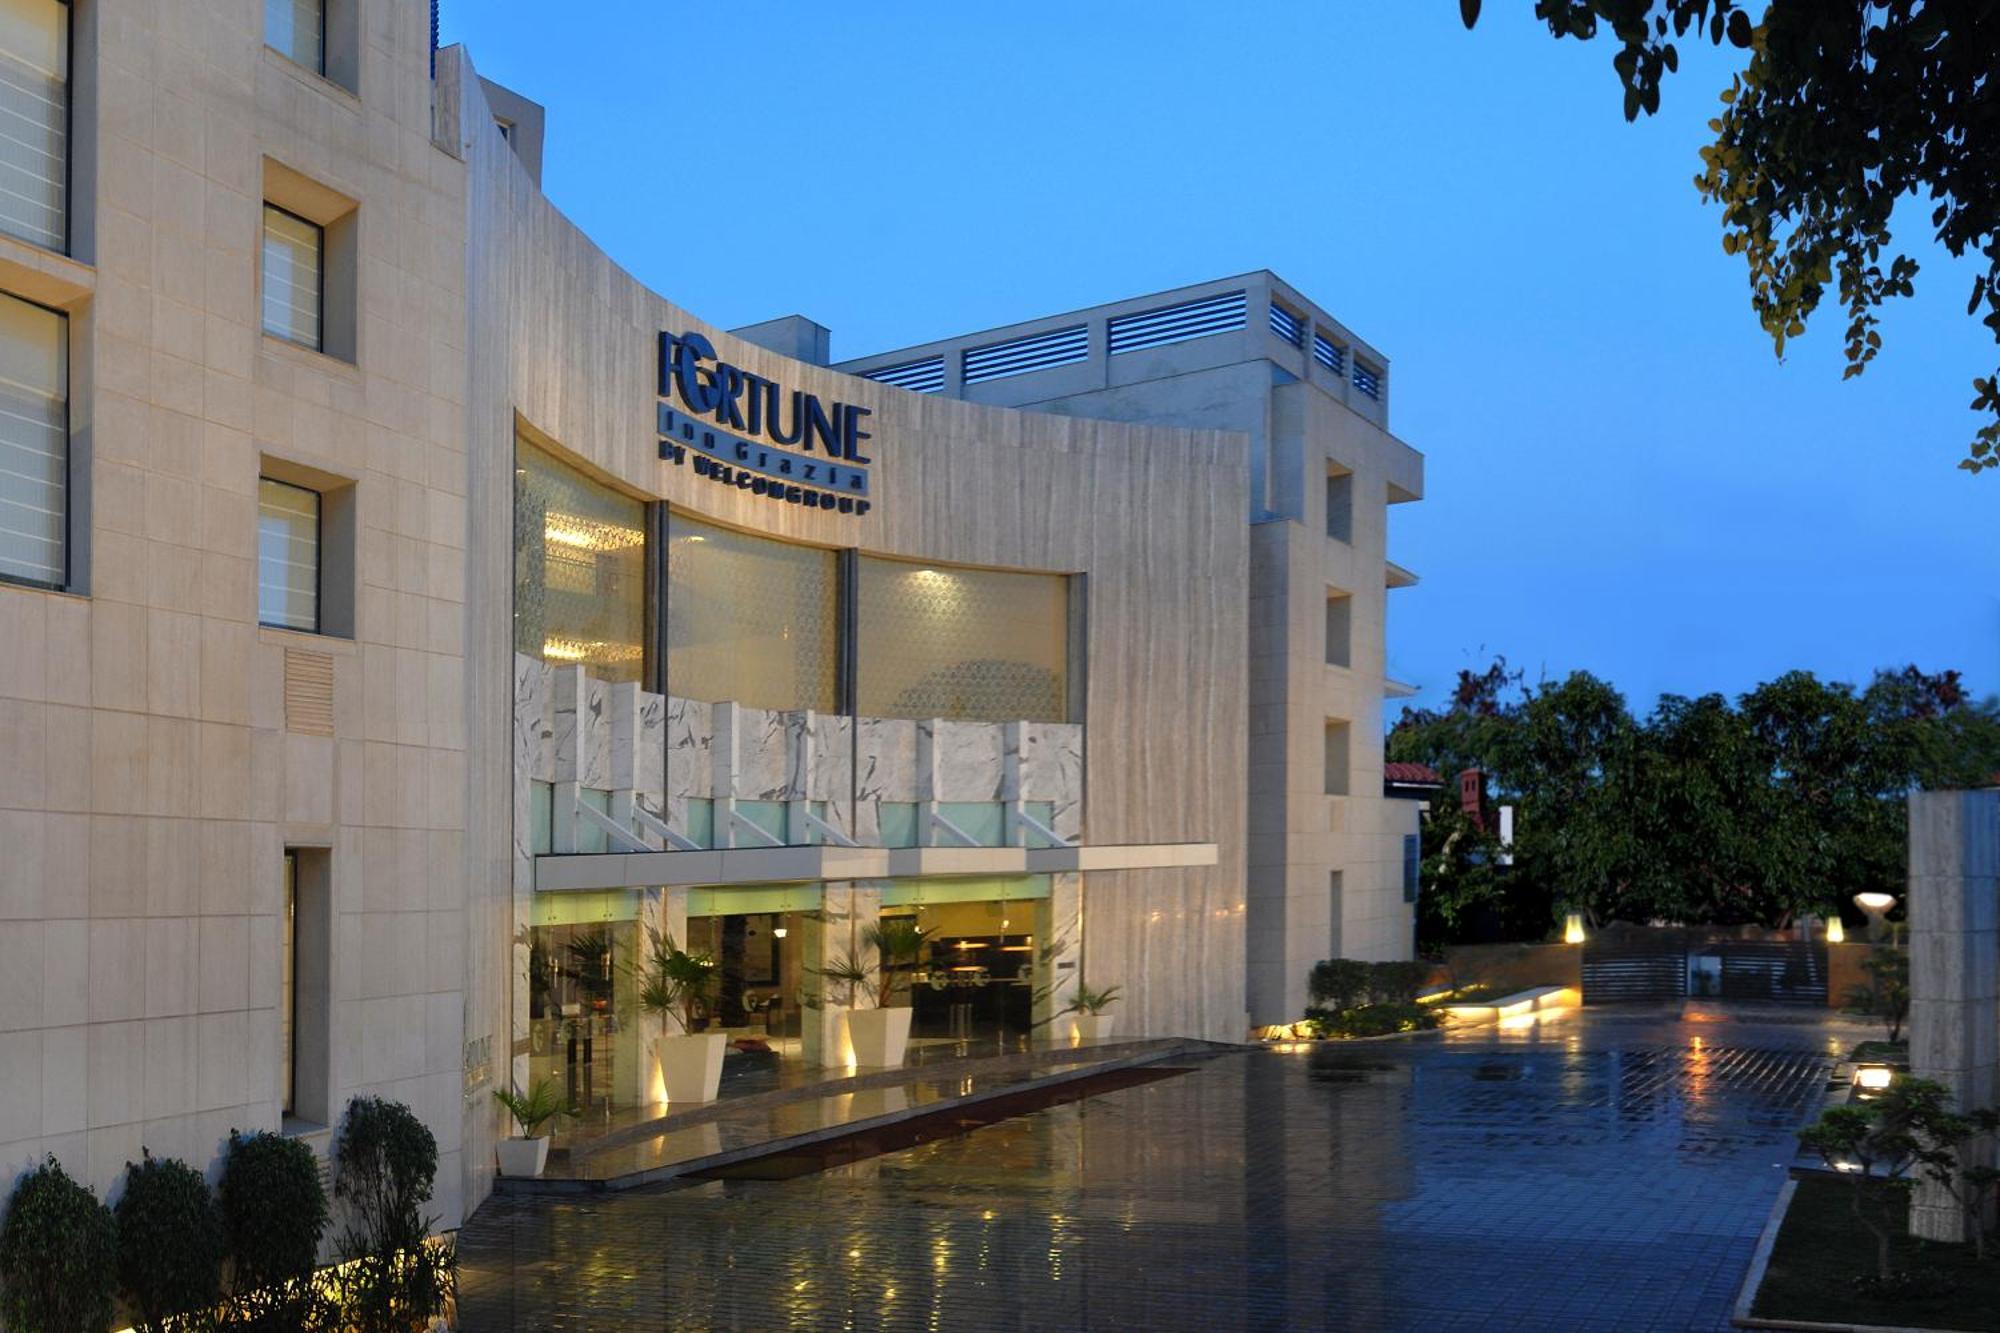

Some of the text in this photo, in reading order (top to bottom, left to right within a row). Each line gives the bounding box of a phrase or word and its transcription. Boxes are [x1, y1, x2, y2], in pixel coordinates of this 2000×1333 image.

[658, 331, 872, 464] FORTUNE
[658, 440, 871, 516] BY WELCOMGROUP
[666, 410, 863, 490] Inn Grazia
